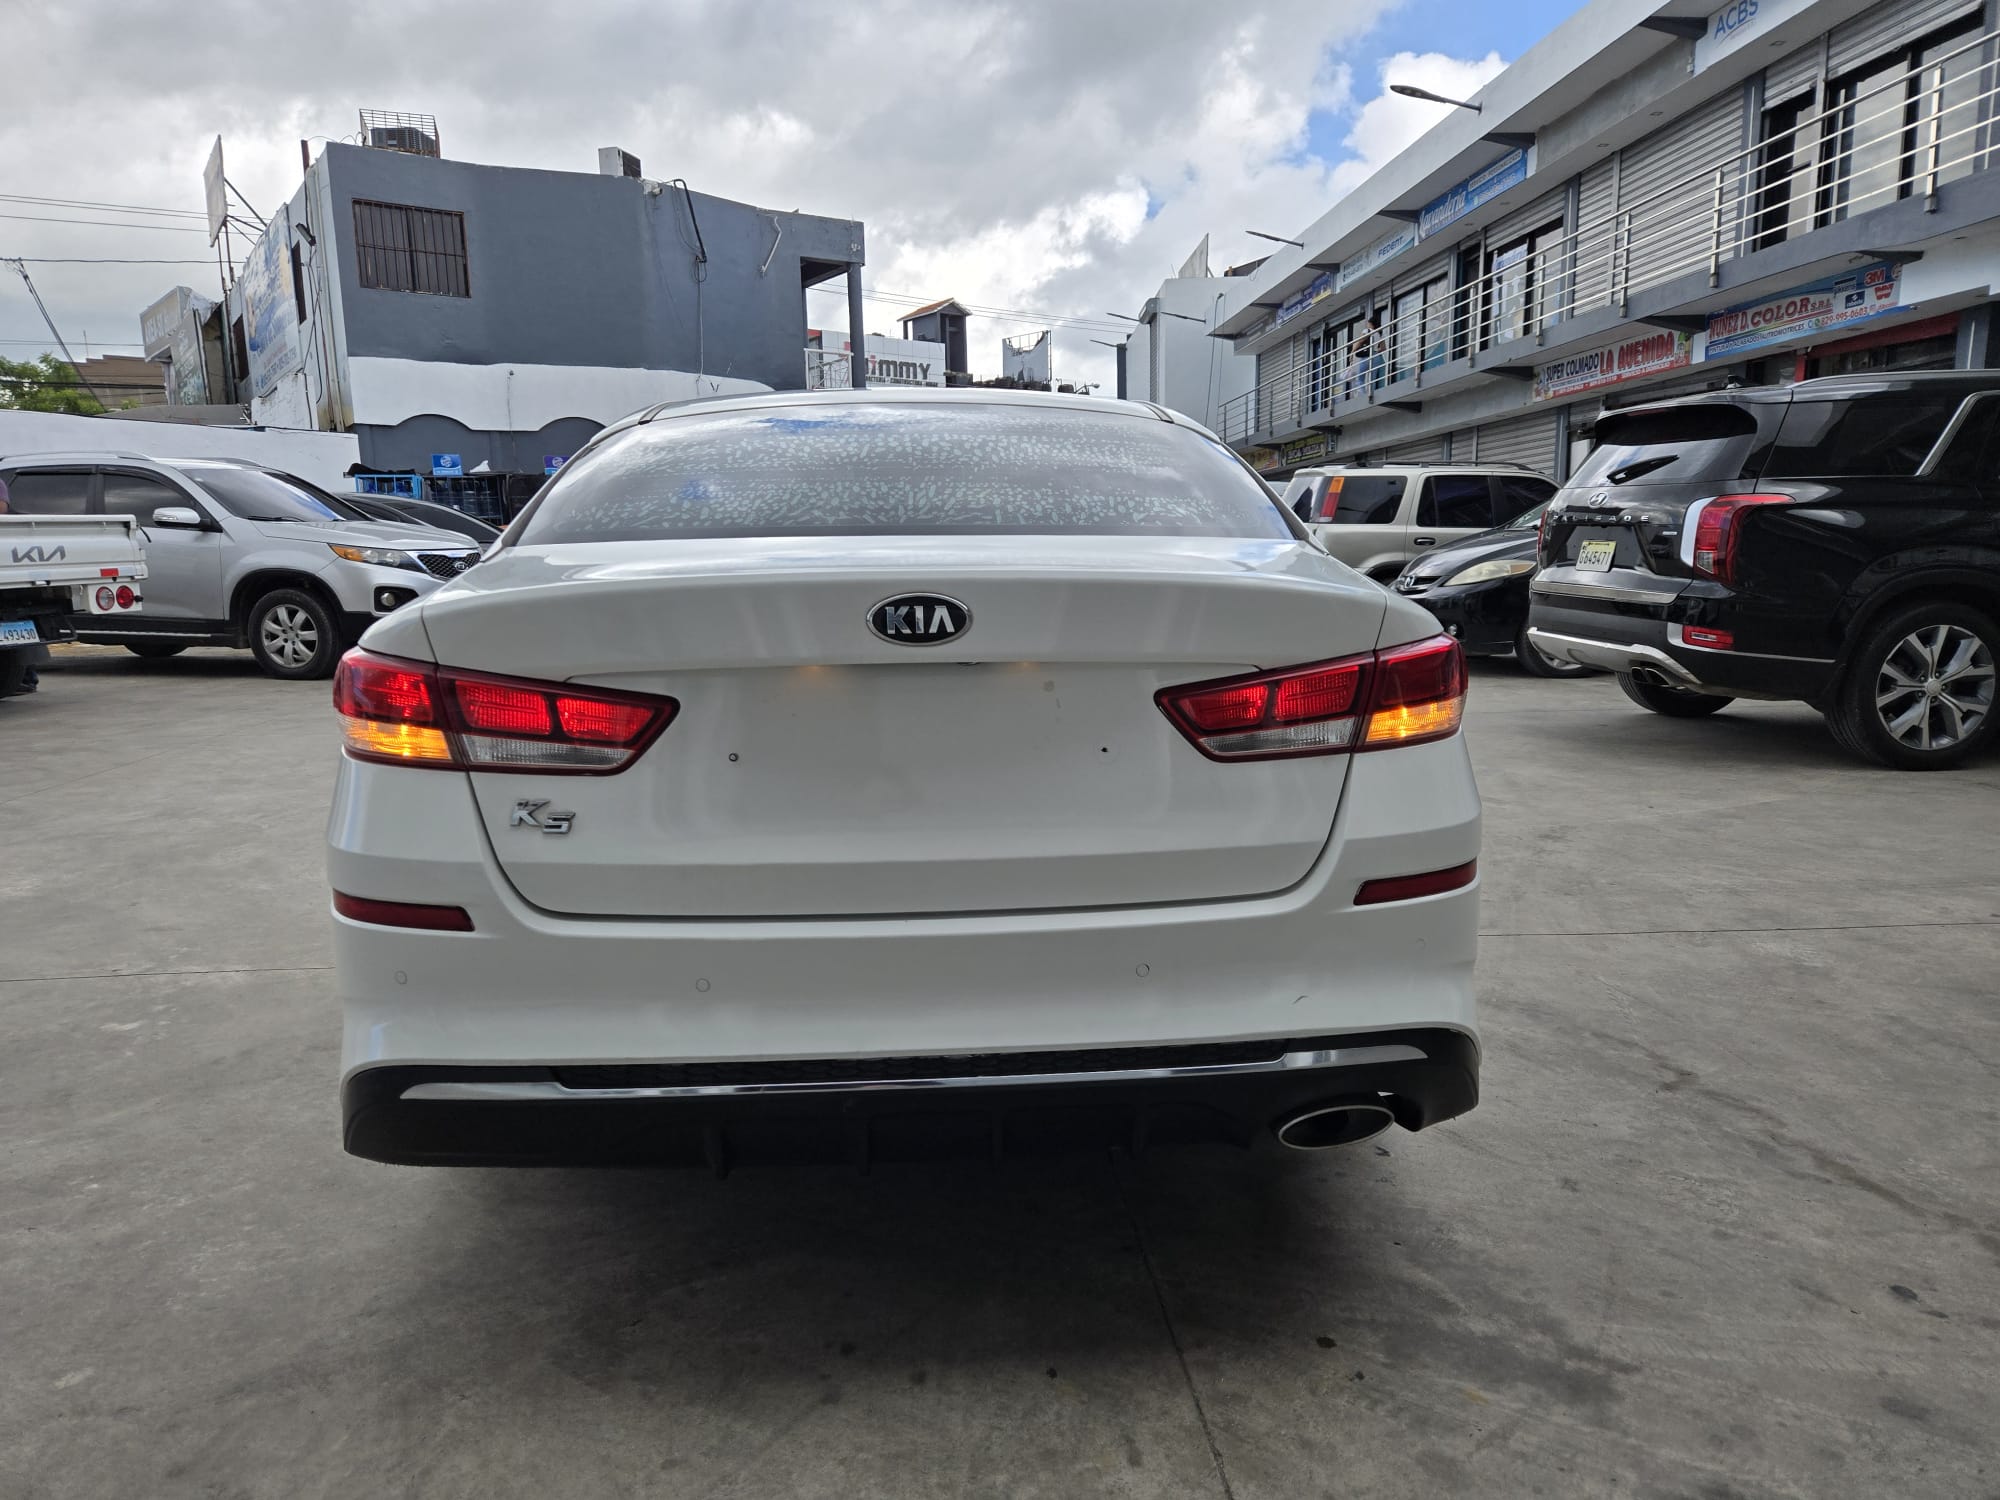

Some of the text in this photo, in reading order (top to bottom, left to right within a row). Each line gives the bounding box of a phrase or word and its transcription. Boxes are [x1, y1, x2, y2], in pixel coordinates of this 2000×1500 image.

[1714, 0, 1758, 40] ACBS
[1864, 269, 1886, 286] 3M
[1751, 297, 1810, 327] COLOR
[864, 354, 931, 380] immy
[1546, 363, 1565, 382] SUPER
[1565, 352, 1600, 377] COLMADO
[1600, 349, 1614, 375] LA
[1617, 331, 1675, 371] AVENIDA
[11, 545, 66, 563] KIA
[1579, 551, 1610, 566] G645471
[885, 605, 955, 634] KIA
[0, 628, 36, 641] 493430
[510, 800, 576, 834] K5
